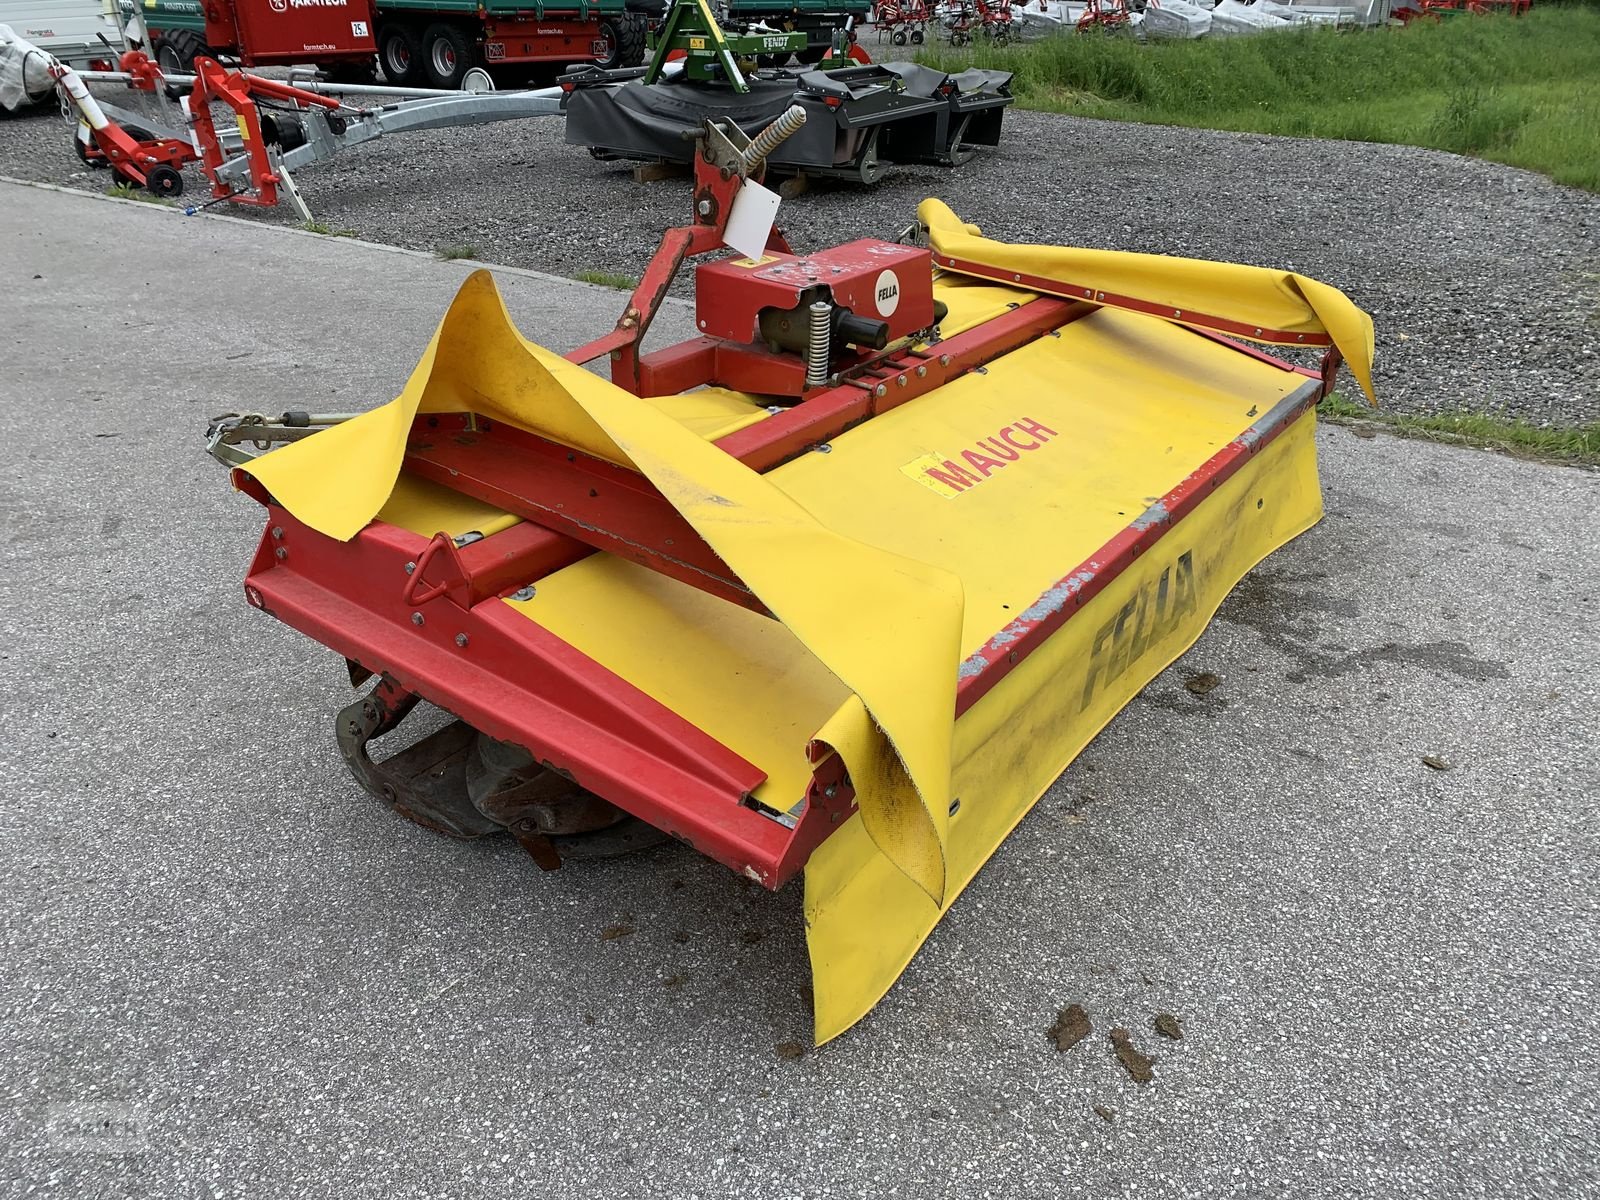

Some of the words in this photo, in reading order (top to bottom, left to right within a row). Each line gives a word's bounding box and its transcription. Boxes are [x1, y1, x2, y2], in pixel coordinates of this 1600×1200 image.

[763, 36, 789, 48] FENDT
[878, 284, 898, 302] FELLA
[925, 417, 1058, 492] MAUCH
[1079, 548, 1199, 714] FELLA
